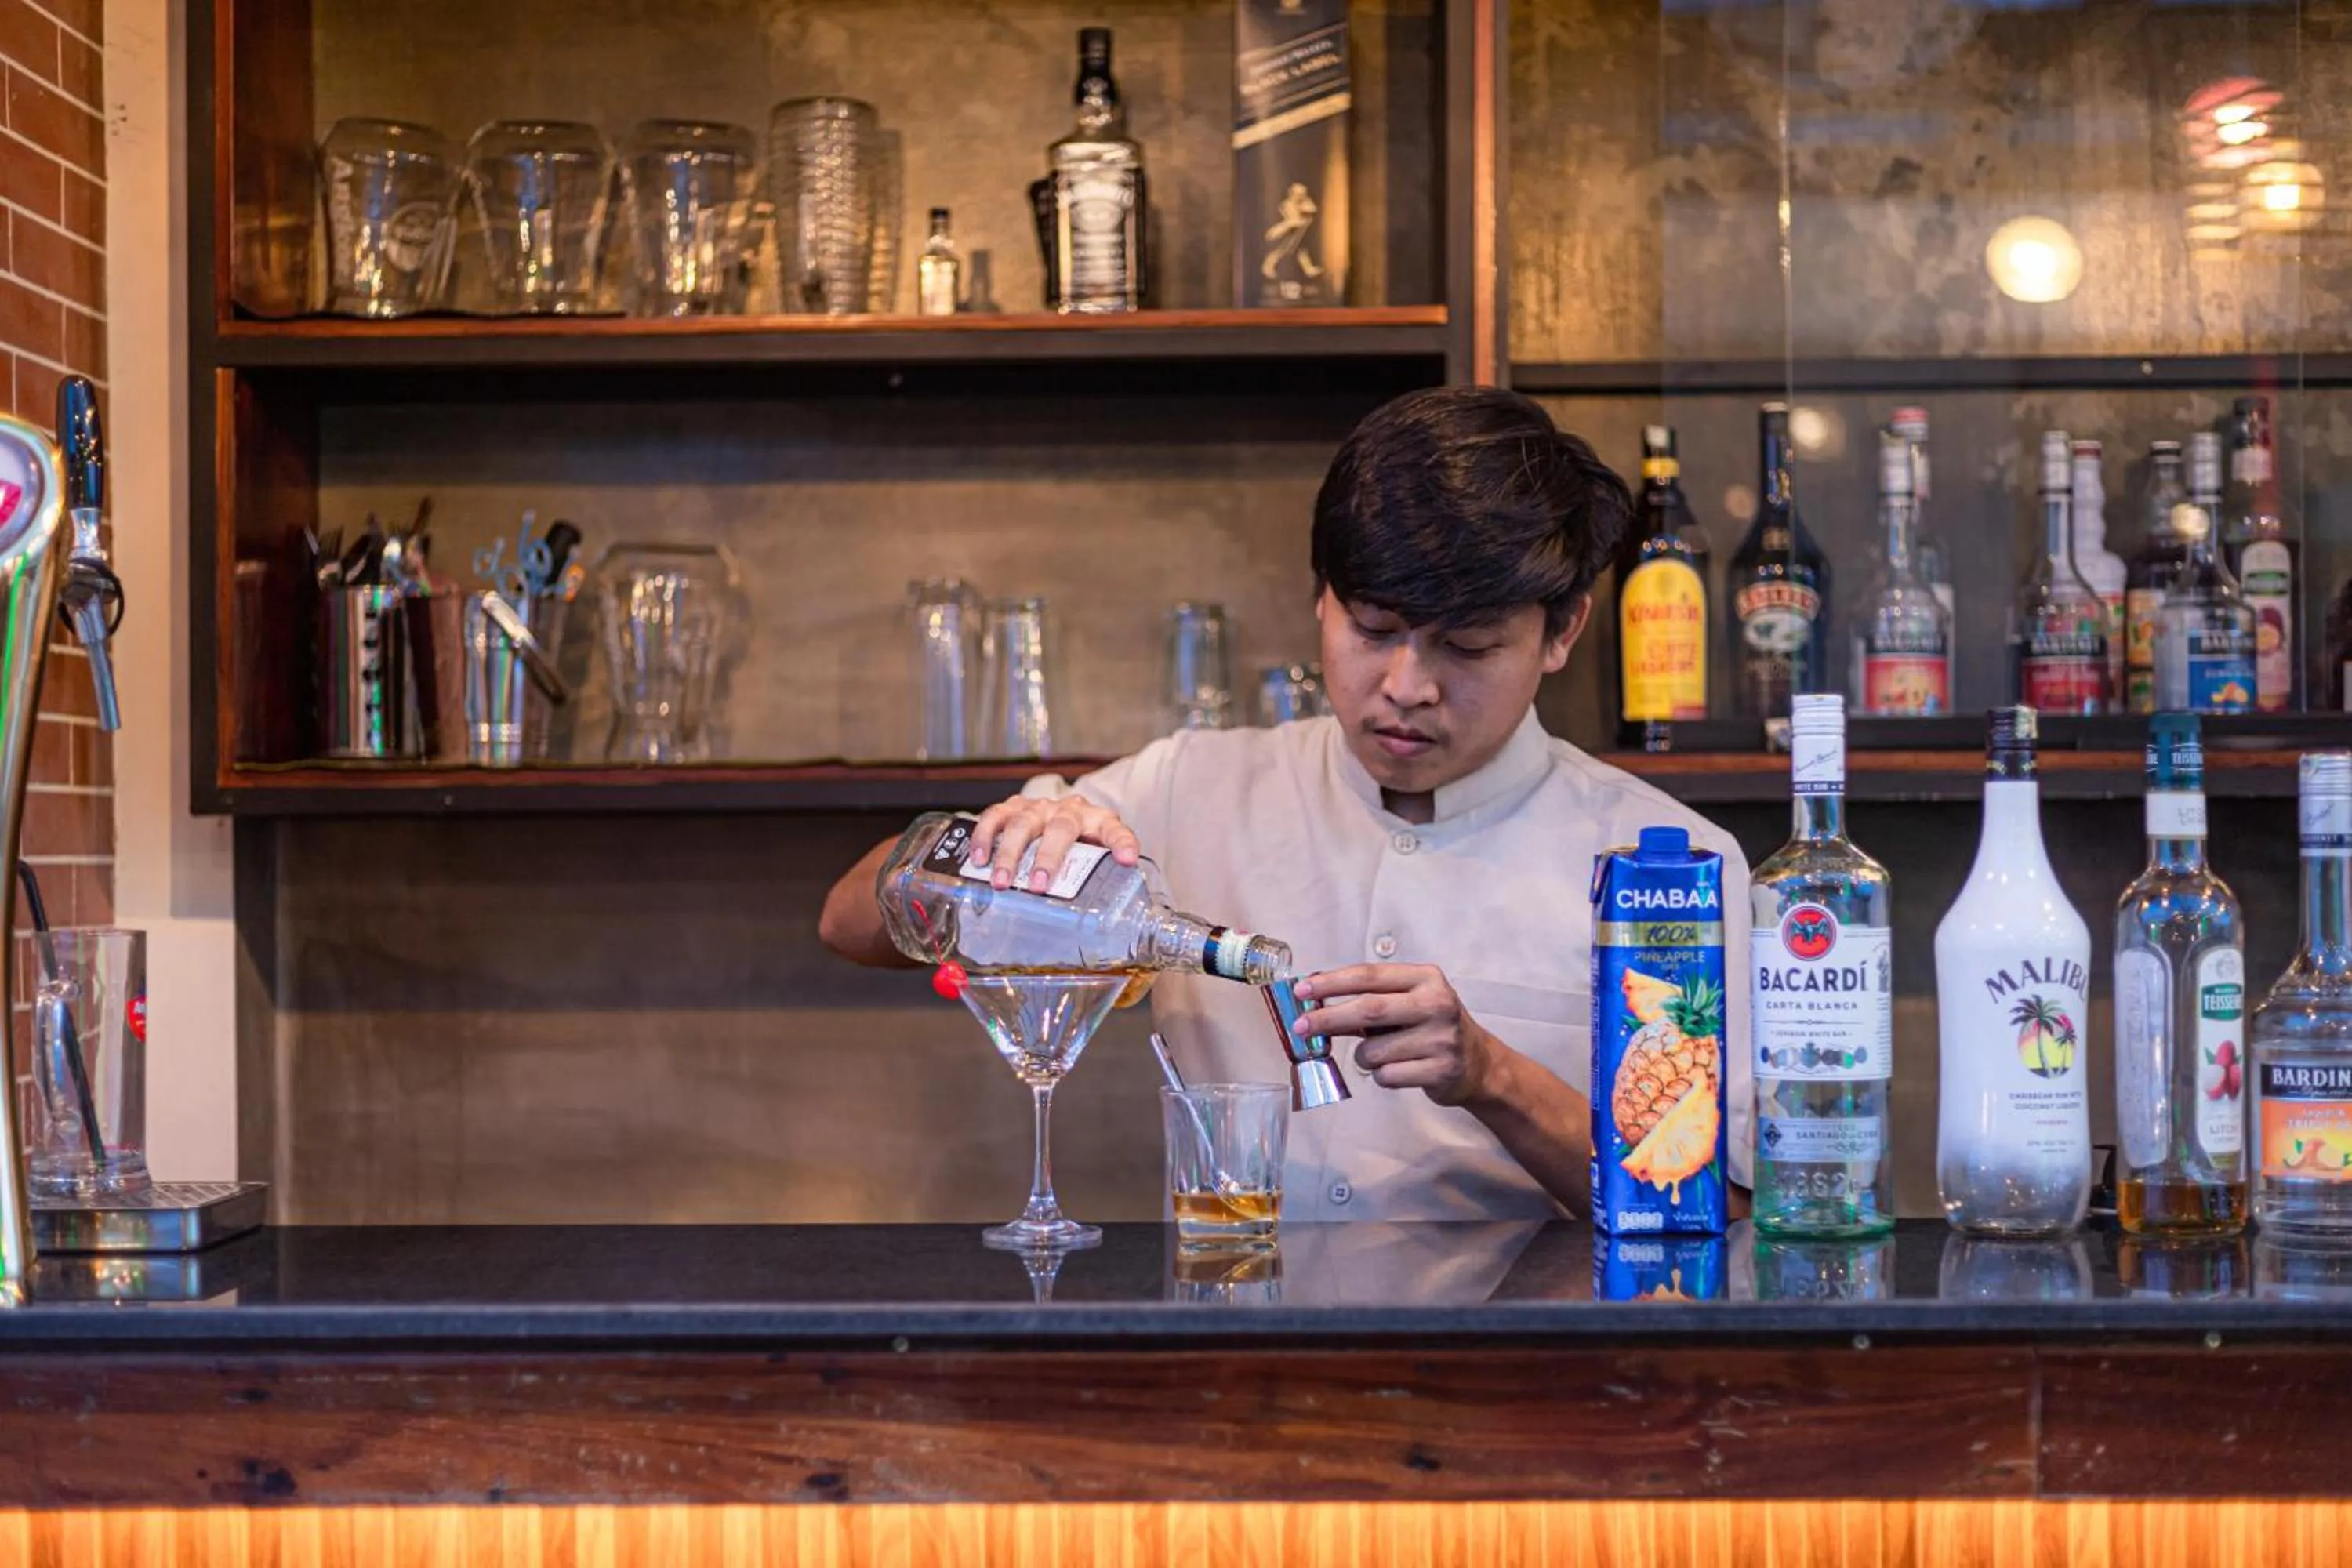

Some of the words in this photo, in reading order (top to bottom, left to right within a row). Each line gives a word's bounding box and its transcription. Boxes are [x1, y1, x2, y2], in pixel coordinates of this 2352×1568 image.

[1616, 887, 1719, 909] CHABAA
[1647, 925, 1696, 942] 100%
[1634, 951, 1706, 963] PINEAPPLE
[1760, 960, 1867, 992] BACARDÍ
[1766, 1001, 1802, 1010] CARTA
[1808, 1001, 1858, 1011] BLANCA
